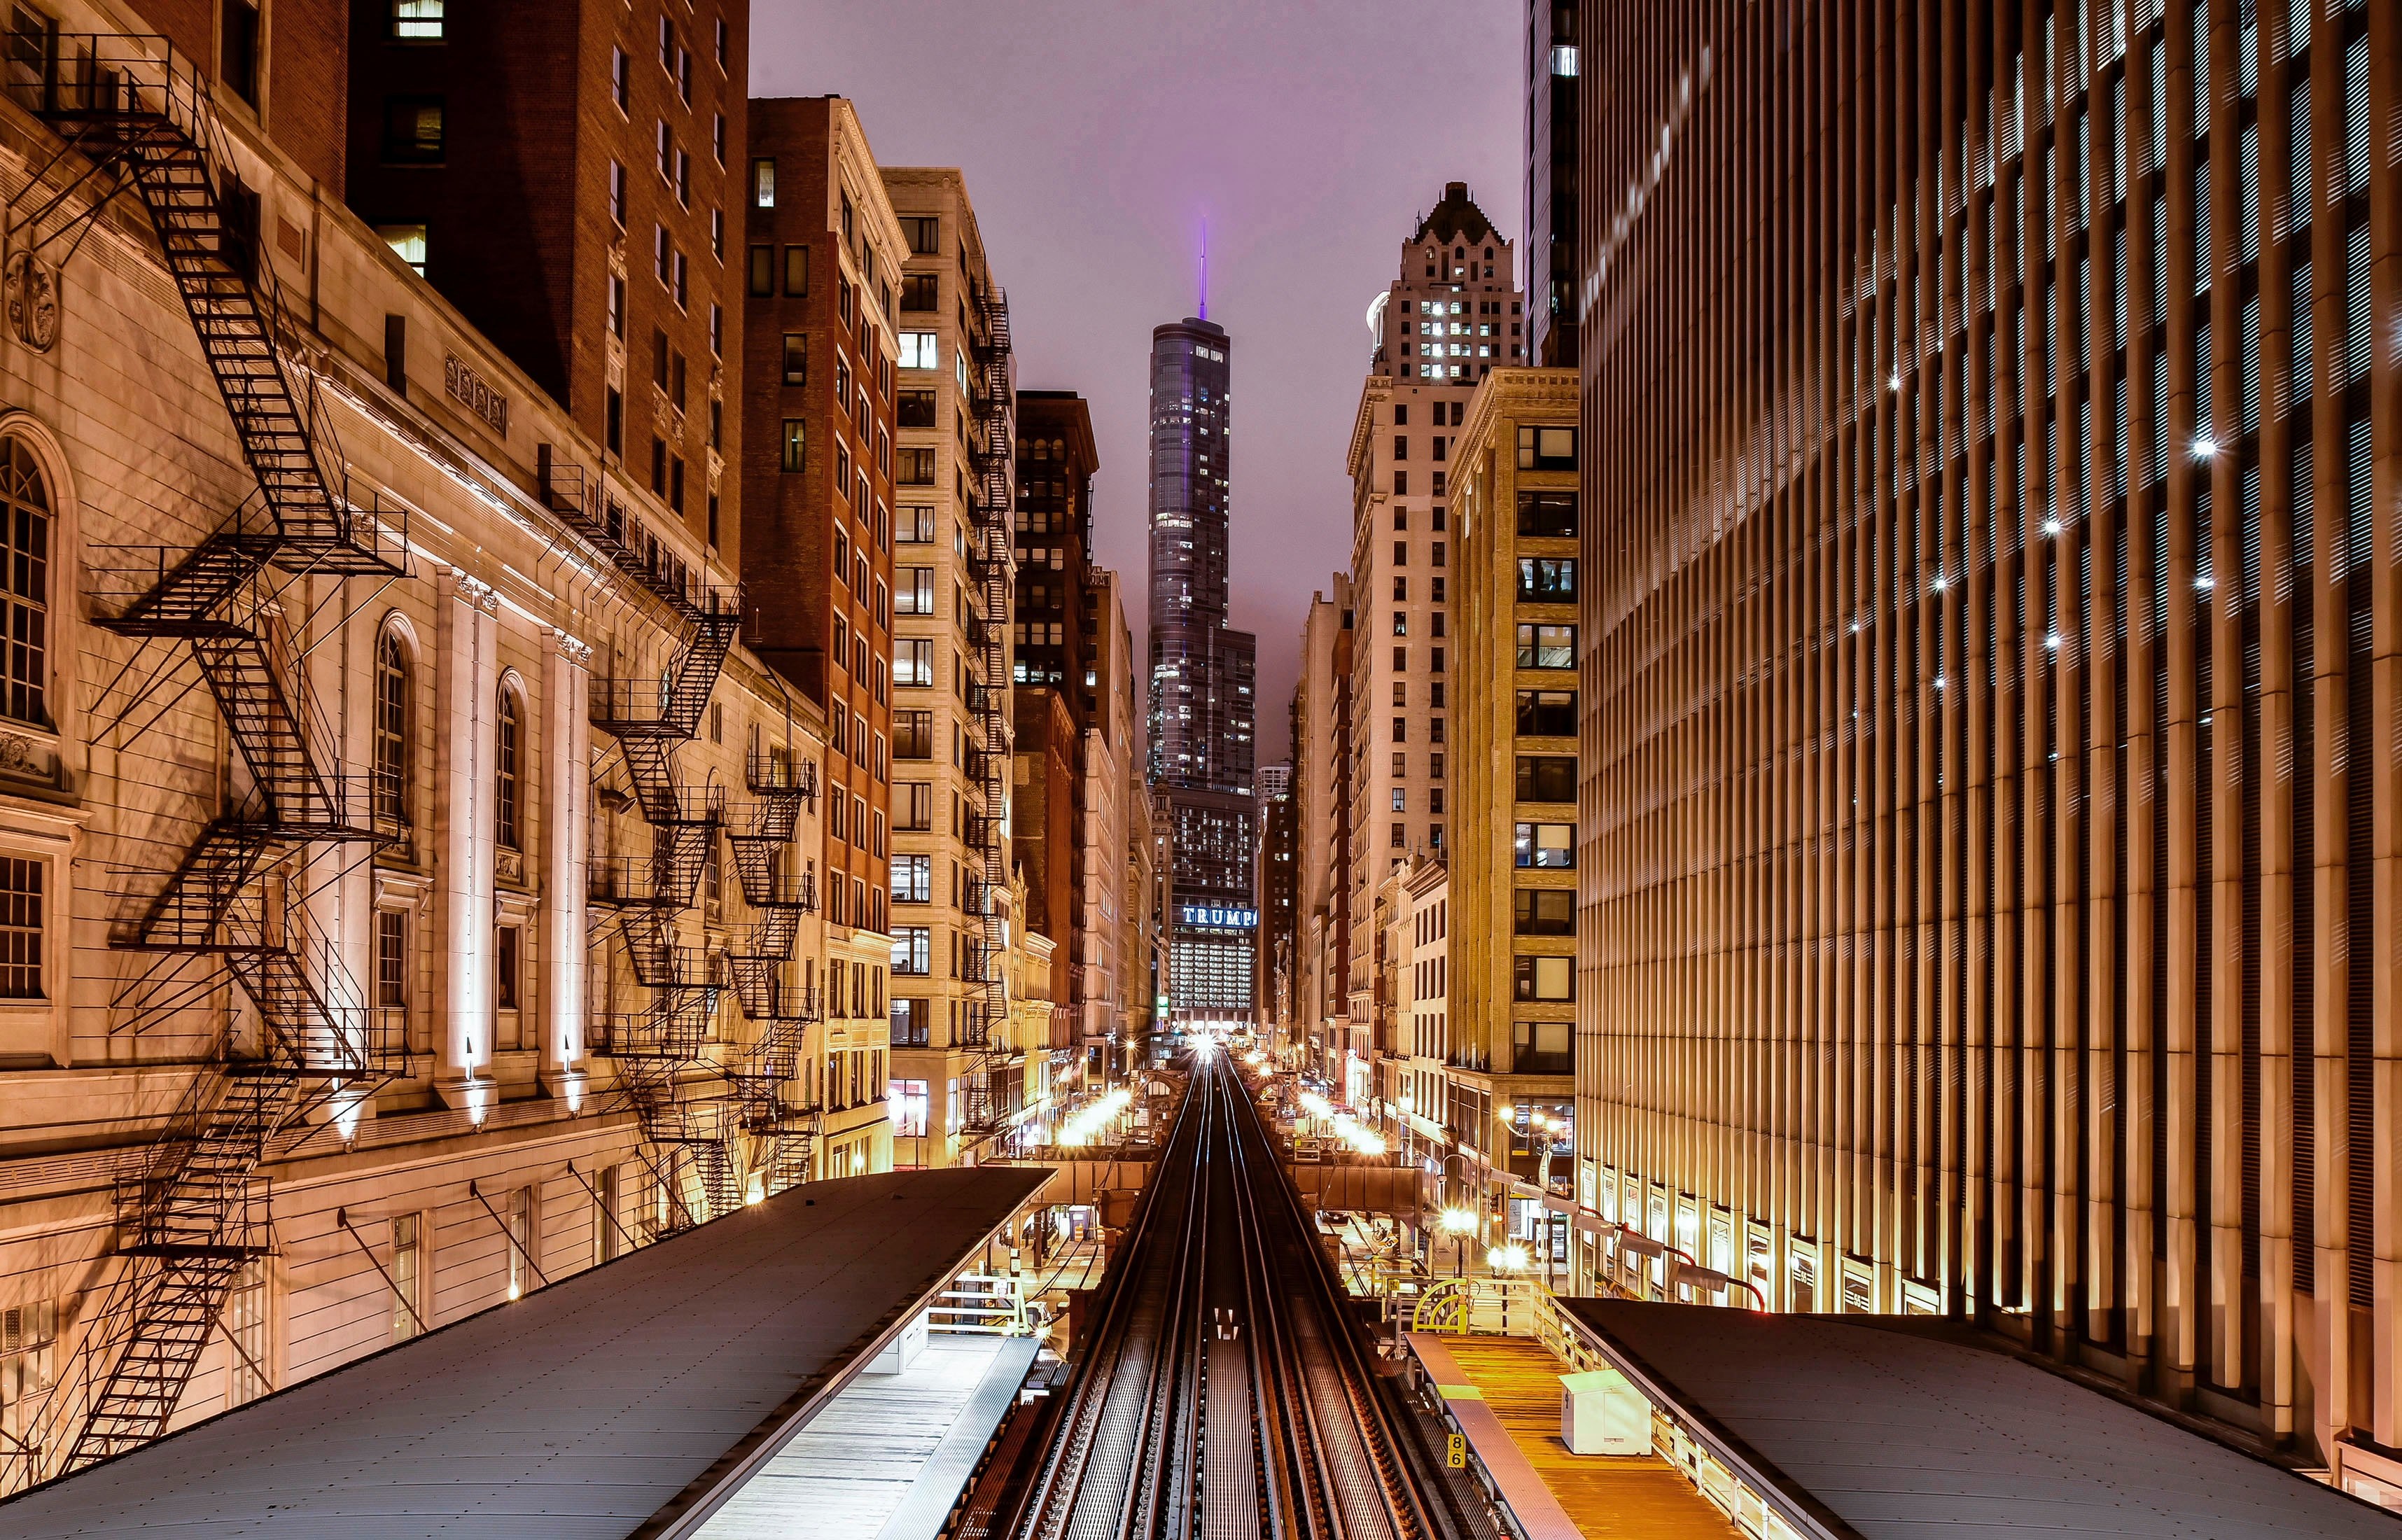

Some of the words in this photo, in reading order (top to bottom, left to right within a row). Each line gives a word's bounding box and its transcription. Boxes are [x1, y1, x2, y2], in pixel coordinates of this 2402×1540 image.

[1183, 907, 1252, 926] TRUMP
[1801, 1270, 1807, 1284] 55
[1854, 1293, 1861, 1308] 55
